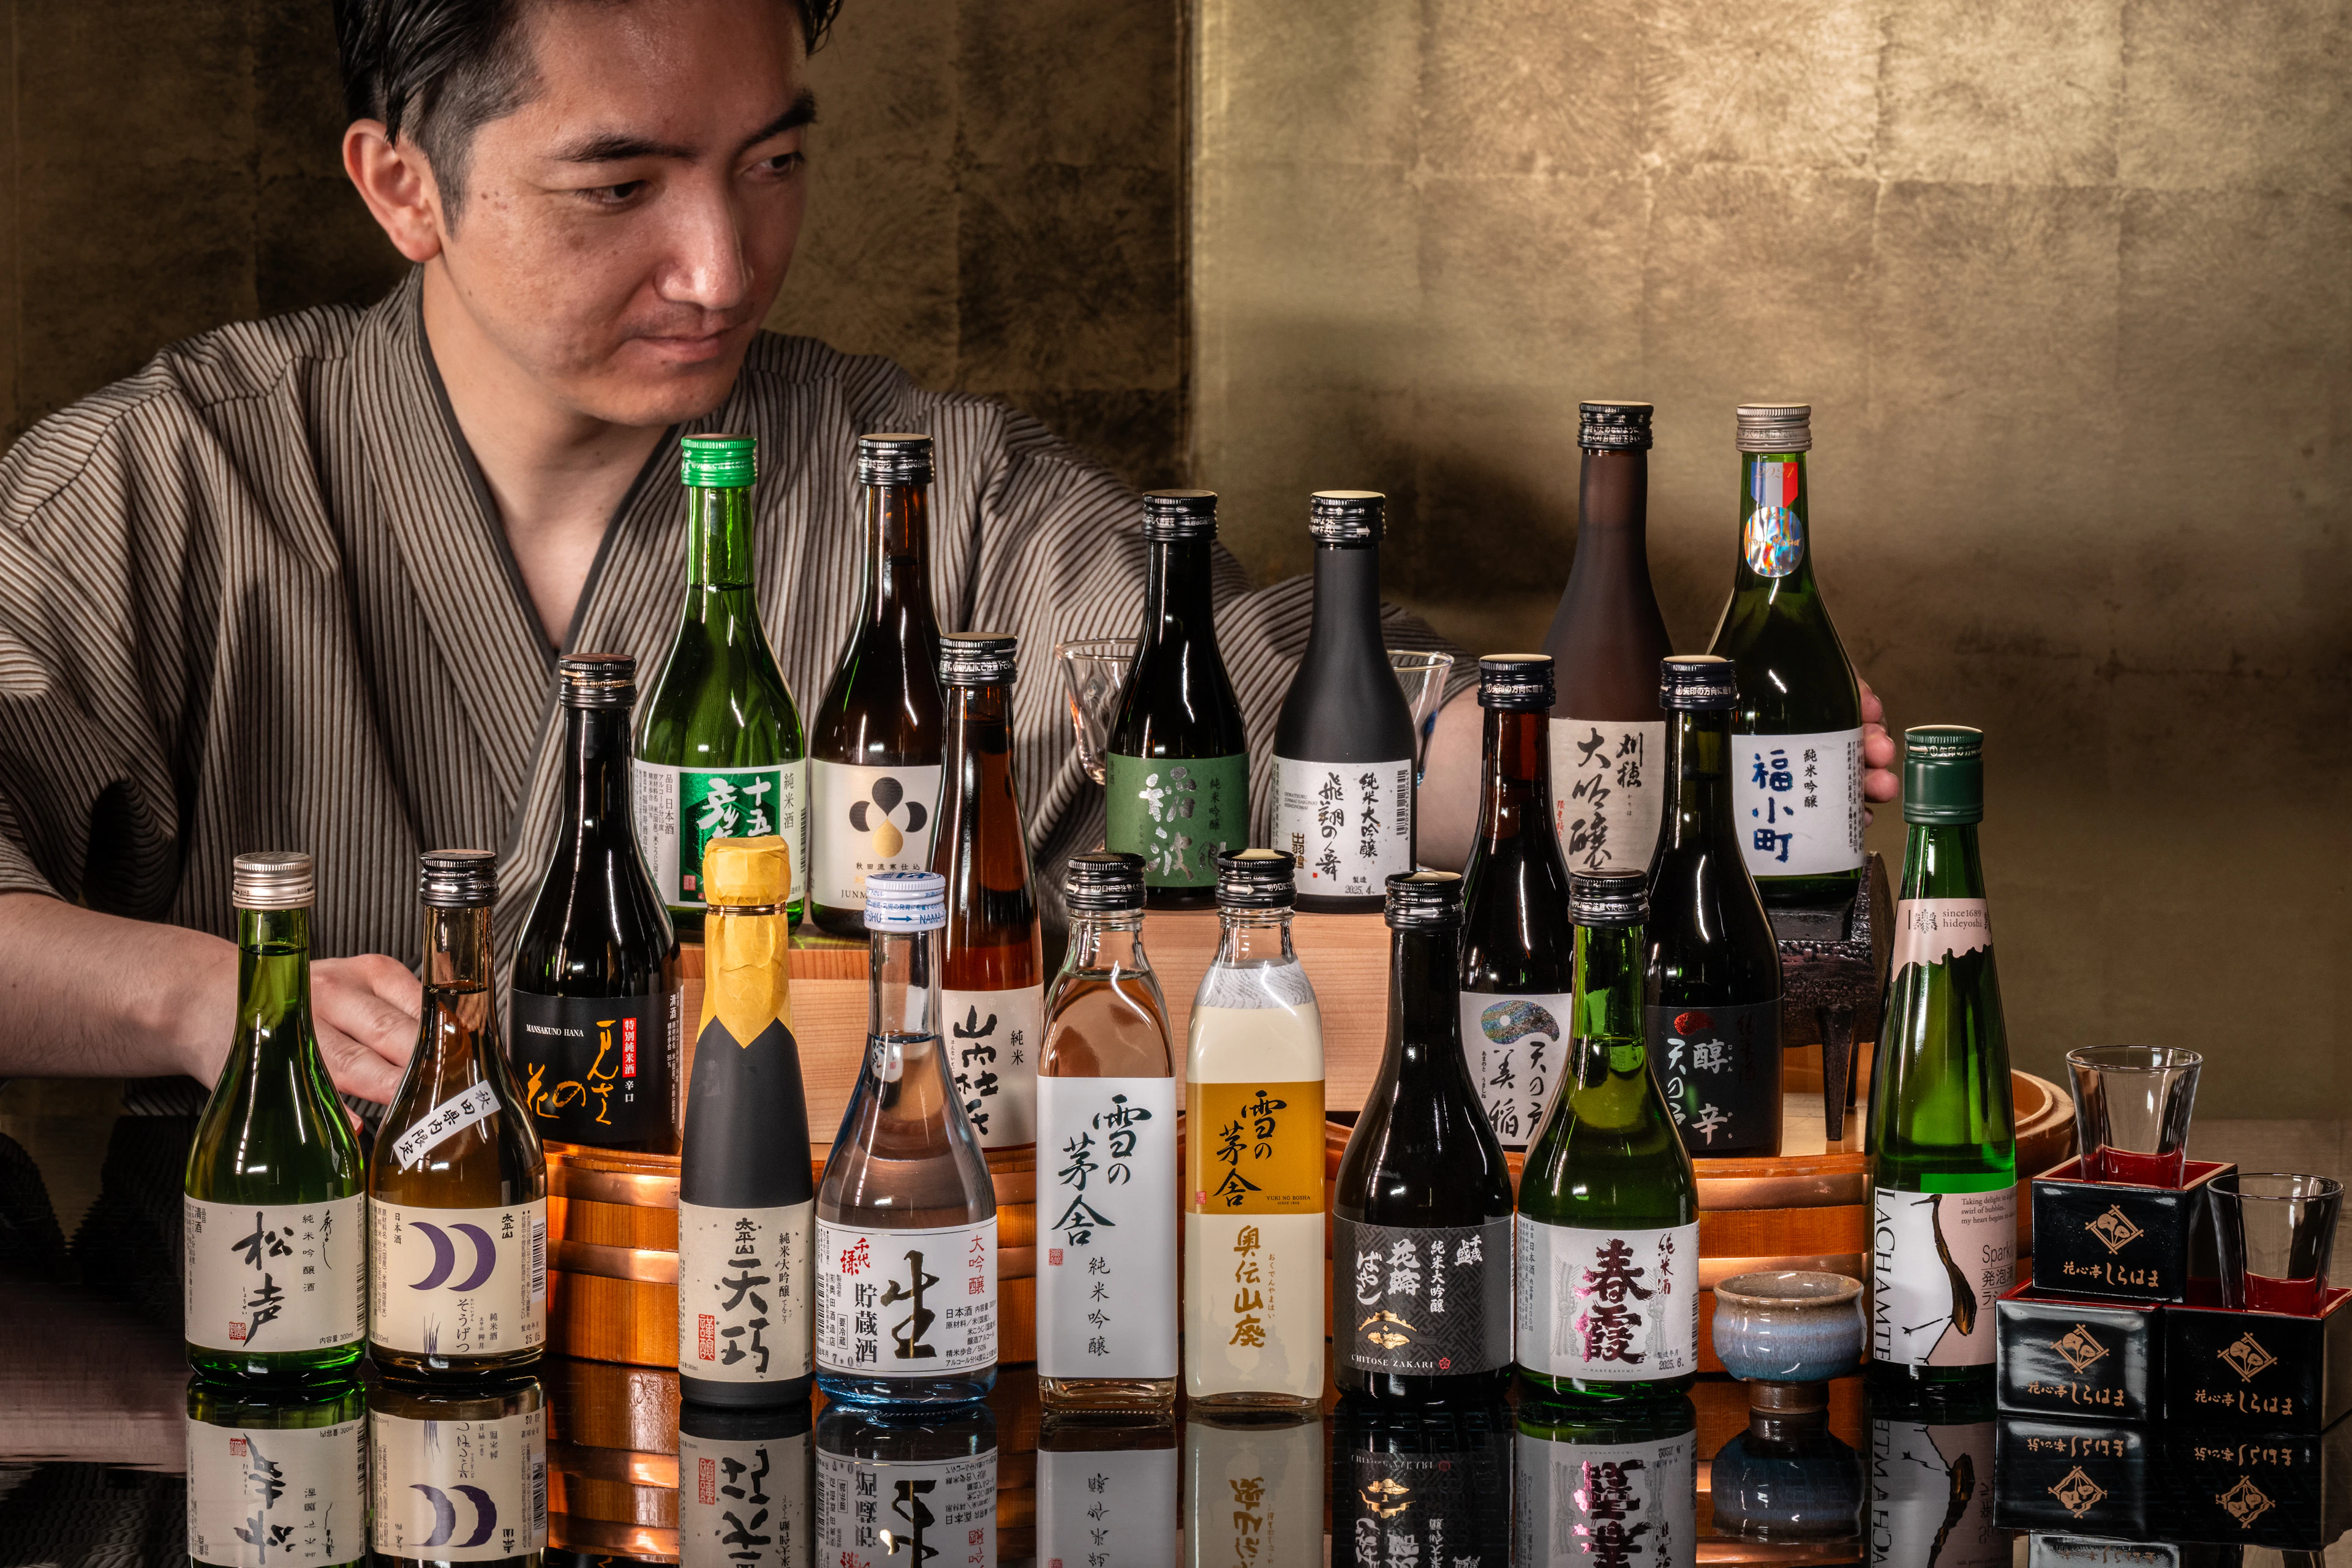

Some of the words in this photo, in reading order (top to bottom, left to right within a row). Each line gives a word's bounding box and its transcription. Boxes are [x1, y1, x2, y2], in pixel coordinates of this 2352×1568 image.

[665, 774, 673, 793] 品目
[783, 773, 794, 829] 純米酒
[1752, 748, 1794, 863] 福小町
[1804, 748, 1818, 809] 純米吟醸
[665, 798, 674, 835] 日本酒
[1359, 772, 1381, 859] 純米大吟醸
[1943, 918, 1982, 929] hideyoshi
[526, 1023, 562, 1036] MANSAKUNO
[564, 1028, 584, 1037] HANA
[624, 1020, 635, 1075] 特別純米酒
[1011, 1029, 1023, 1066] 純米
[624, 1080, 635, 1102] 辛口
[399, 1090, 491, 1162] 秋田県内限定
[1961, 1198, 1983, 1207] Taking
[1984, 1196, 2001, 1205] delight
[1961, 1207, 1976, 1215] swirl
[1989, 1213, 2004, 1224] begins
[231, 1211, 295, 1348] 松声
[303, 1214, 315, 1292] 純米吟醸酒
[778, 1232, 791, 1297] 純米大吟醸
[968, 1234, 985, 1295] 大吟醸
[1356, 1251, 1382, 1305] ばやし
[1385, 1238, 1420, 1296] 花輪
[1430, 1240, 1446, 1313] 純米大吟醸
[1657, 1232, 1675, 1295] 純米酒
[2063, 1261, 2102, 1278] 花心亭
[2106, 1262, 2159, 1288] しらはま
[880, 1250, 940, 1359] 生
[946, 1305, 973, 1319] 日本酒
[975, 1302, 989, 1314] 内容量
[1088, 1257, 1110, 1355] 純米吟醸
[1229, 1225, 1266, 1348] 奥伝山廃
[1573, 1238, 1657, 1365] 春霞
[319, 1335, 338, 1344] 内容量
[340, 1331, 353, 1341] 300ml
[456, 1298, 470, 1352] そうげつ
[489, 1312, 498, 1341] 純米酒
[526, 1334, 532, 1344] 25
[535, 1332, 540, 1341] 05
[854, 1282, 878, 1363] 貯蔵酒
[1351, 1354, 1389, 1366] CHITOSE
[1393, 1360, 1433, 1369] ZAKARI
[1656, 1349, 1679, 1359] 製造年月
[2027, 1381, 2067, 1398] 花心亭
[2071, 1382, 2125, 1407] しらはま
[2195, 1390, 2234, 1406] 花心亭
[2239, 1390, 2293, 1415] しらはま
